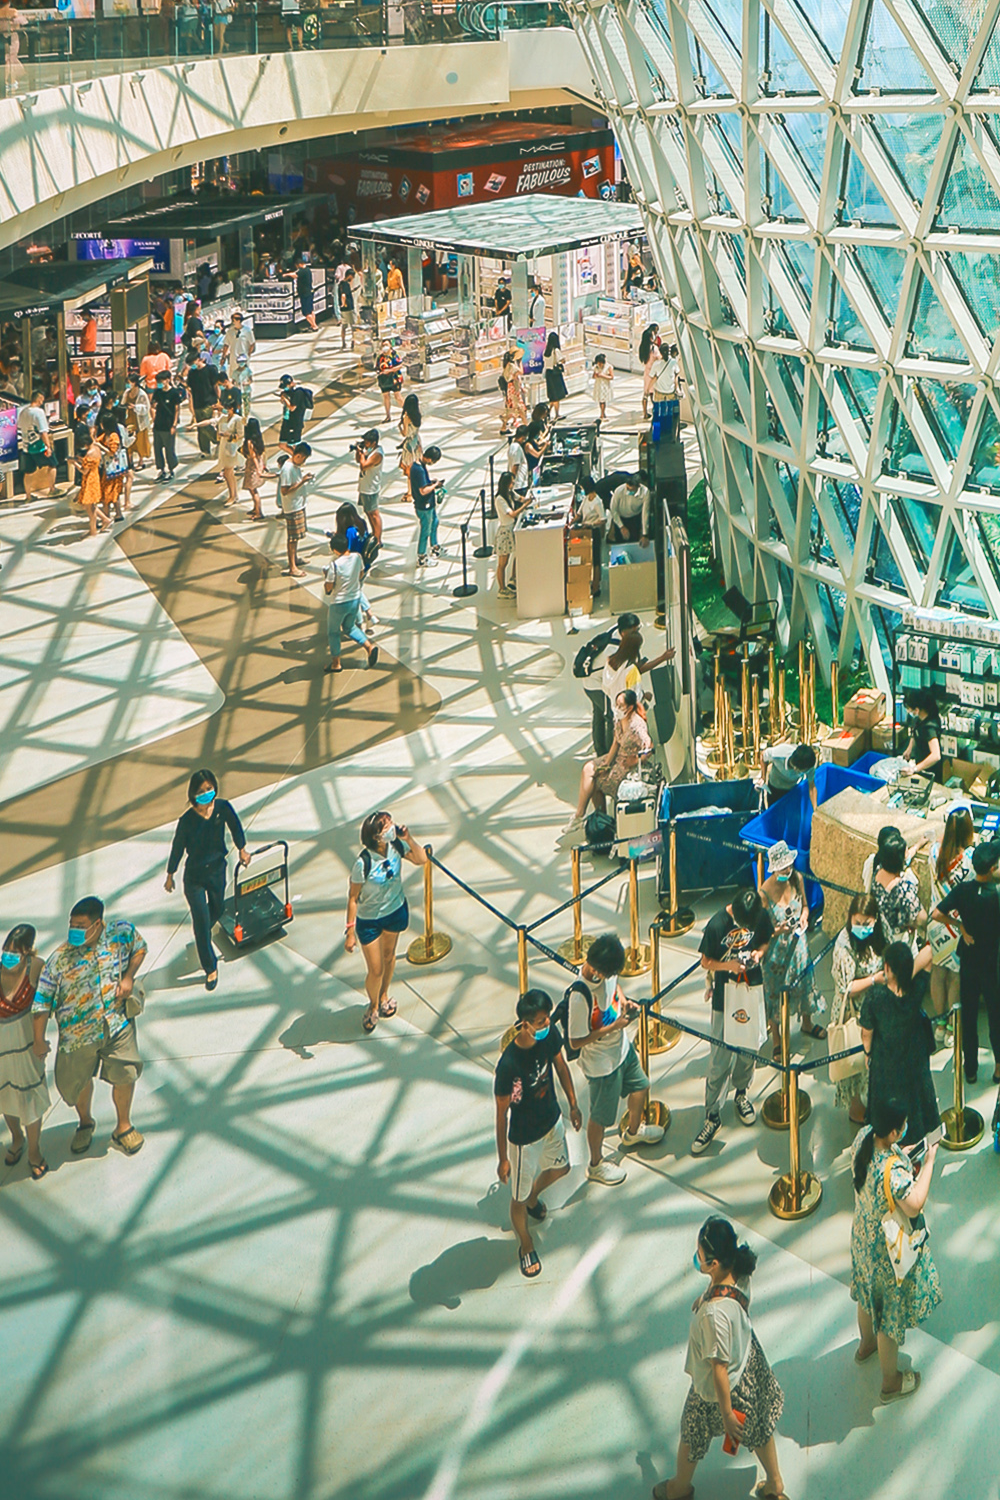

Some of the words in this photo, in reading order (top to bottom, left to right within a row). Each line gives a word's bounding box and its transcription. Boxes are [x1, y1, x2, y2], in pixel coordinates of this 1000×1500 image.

[520, 141, 566, 155] MAC
[359, 152, 389, 163] MAC
[523, 158, 566, 173] DESTINATION:
[515, 167, 571, 193] FABULOUS
